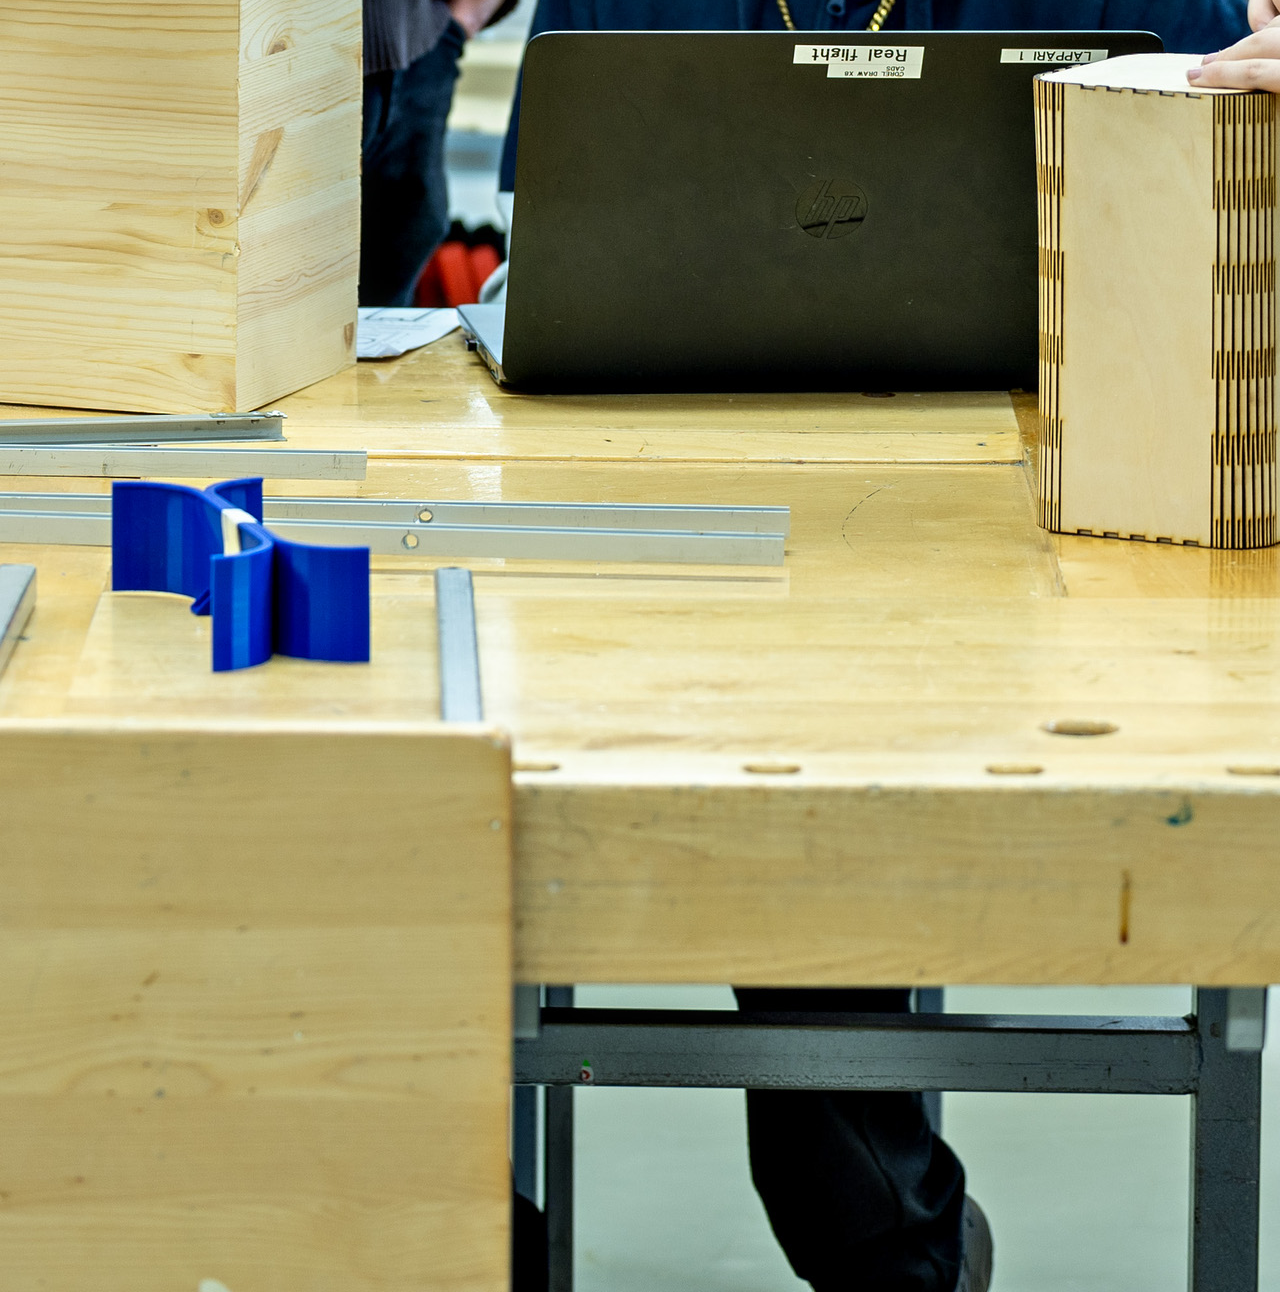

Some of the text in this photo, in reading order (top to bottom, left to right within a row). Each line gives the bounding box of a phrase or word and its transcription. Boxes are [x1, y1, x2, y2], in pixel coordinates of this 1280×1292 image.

[811, 48, 907, 62] Real flight
[1019, 51, 1092, 62] LÄPPÄRI 1
